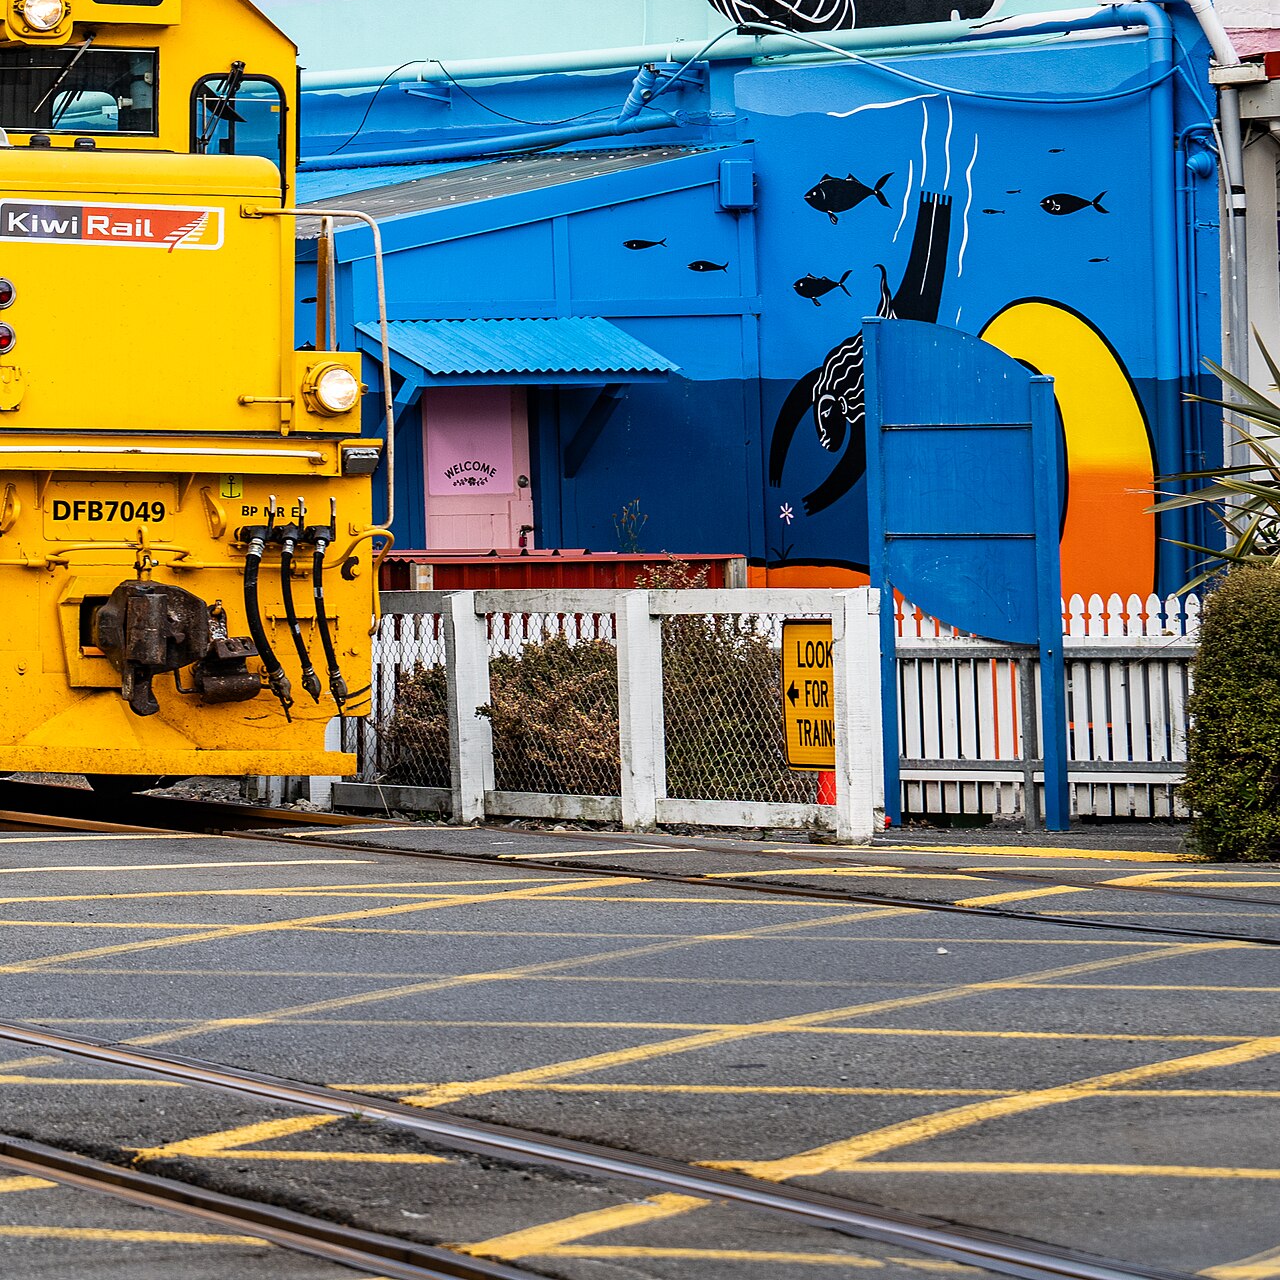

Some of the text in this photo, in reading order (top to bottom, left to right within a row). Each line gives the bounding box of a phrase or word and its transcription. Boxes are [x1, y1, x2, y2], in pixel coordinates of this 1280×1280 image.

[7, 211, 154, 238] KiwiRail
[444, 460, 497, 480] WELCOME
[52, 500, 166, 523] DFB7049
[241, 505, 258, 517] BP
[797, 640, 834, 669] LOOK
[804, 680, 829, 708] FOR
[797, 718, 836, 748] TRAIN
